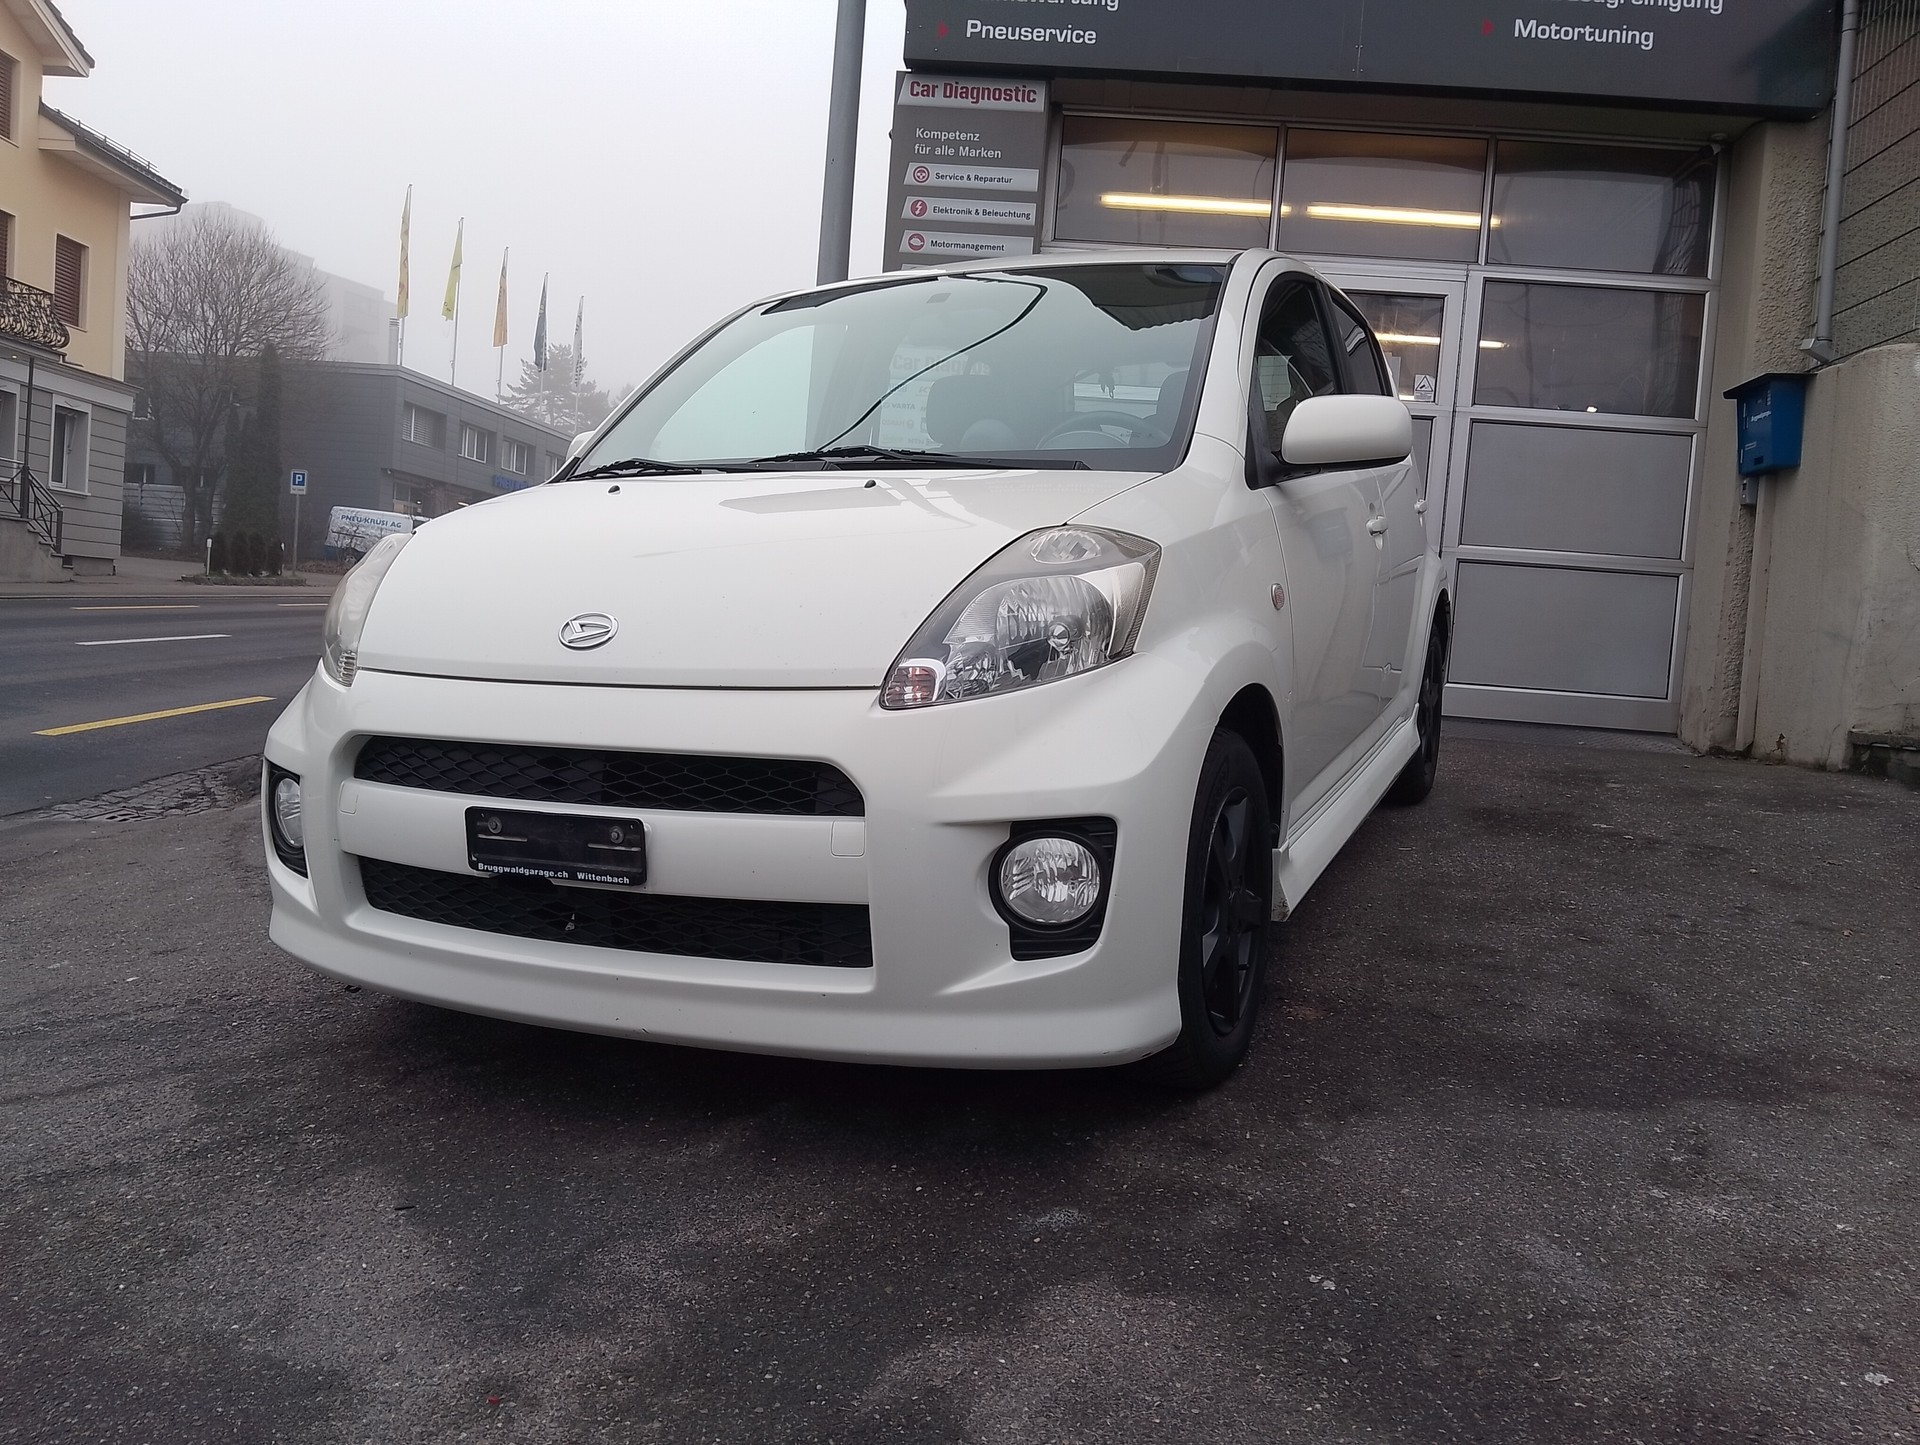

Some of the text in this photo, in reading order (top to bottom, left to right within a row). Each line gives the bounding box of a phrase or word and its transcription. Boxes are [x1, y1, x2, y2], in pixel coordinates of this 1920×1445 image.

[966, 19, 1097, 44] Pneuservice
[1514, 18, 1655, 50] Motortuning
[910, 81, 1037, 104] Car Diagnostic
[915, 128, 980, 141] Kompetenz
[914, 144, 1002, 158] für alle Marken
[935, 172, 1013, 184] Service & Reparatur
[933, 206, 1031, 220] Elektronik & Beleuchtung
[930, 240, 1005, 251] Motormanagement
[478, 863, 630, 884] Bruggwaldgarage.ch Wittenbach
